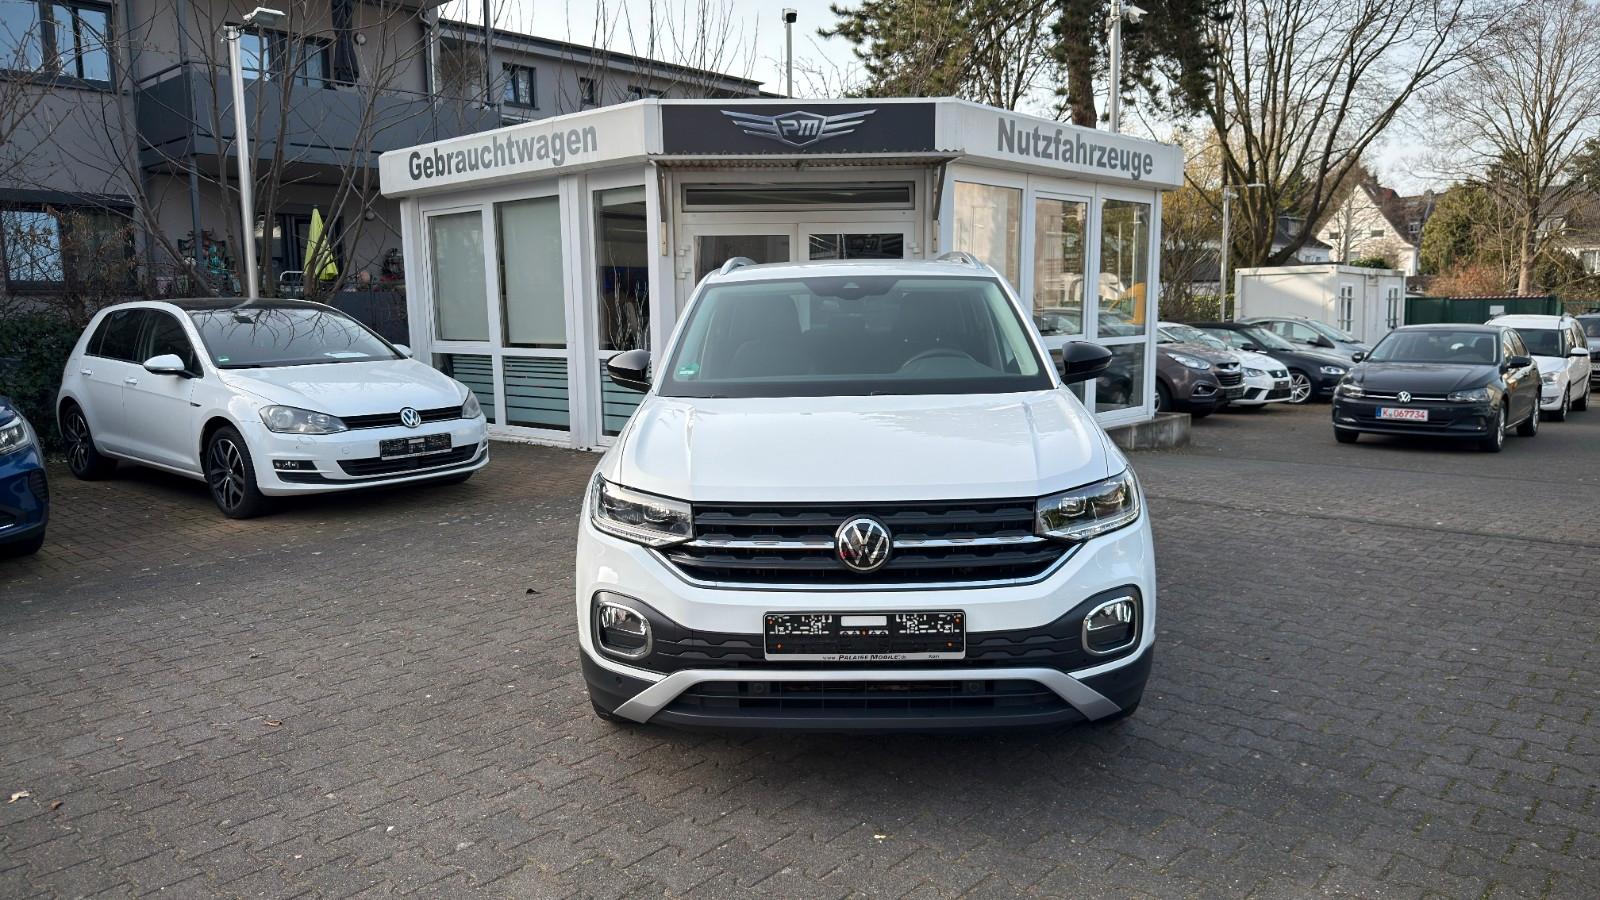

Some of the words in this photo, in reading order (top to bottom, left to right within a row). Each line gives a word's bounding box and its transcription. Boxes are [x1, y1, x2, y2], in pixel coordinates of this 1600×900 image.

[408, 124, 598, 181] Gebrauchtwagen
[997, 117, 1154, 180] Nutzfahrzeuge
[839, 518, 890, 570] VW
